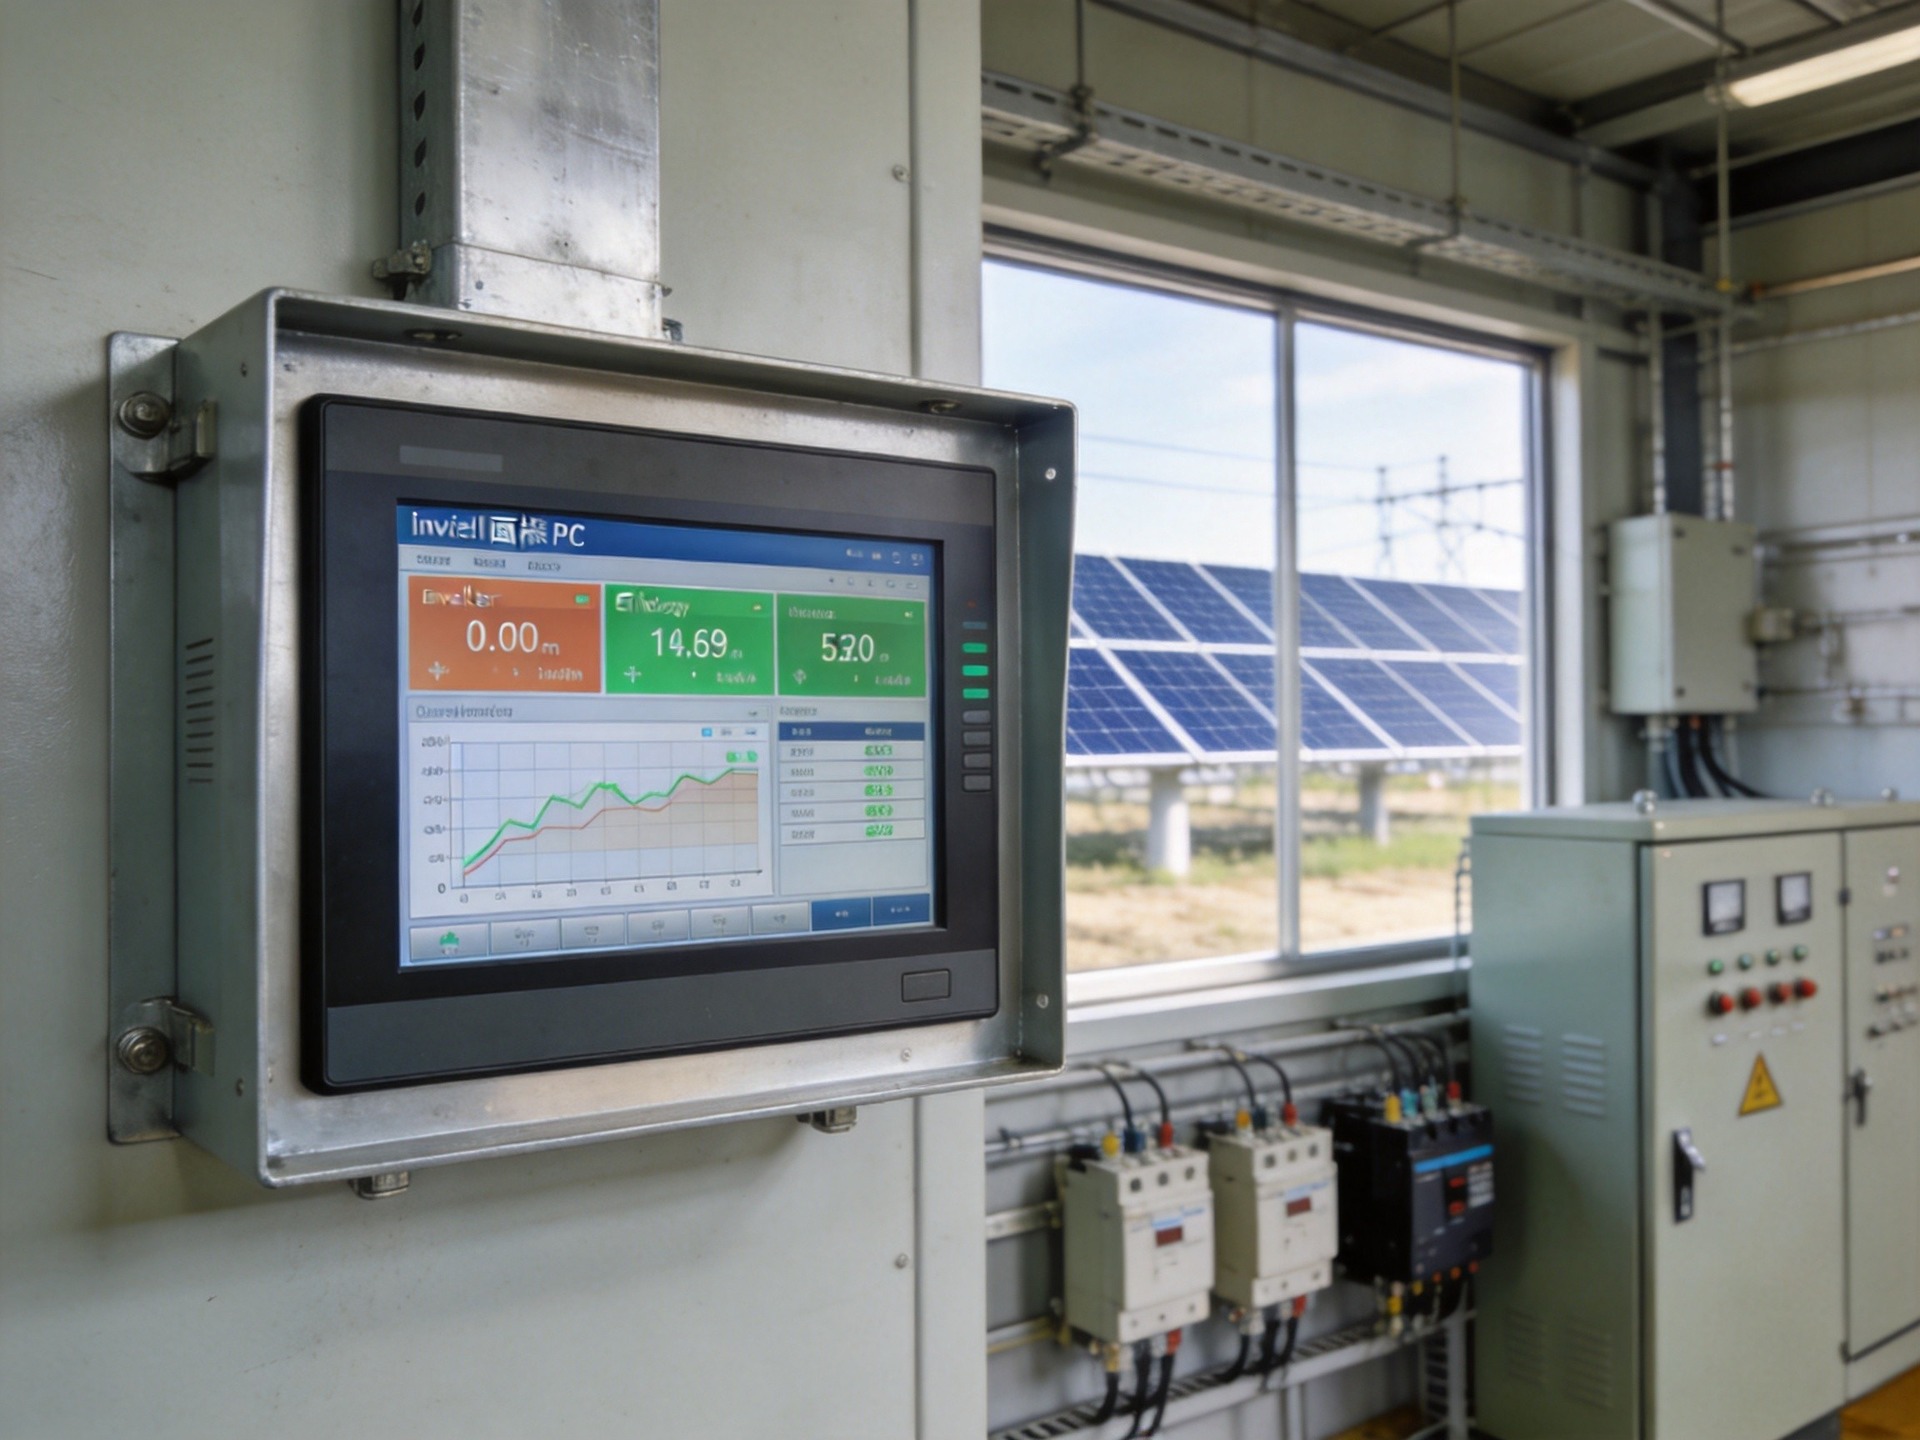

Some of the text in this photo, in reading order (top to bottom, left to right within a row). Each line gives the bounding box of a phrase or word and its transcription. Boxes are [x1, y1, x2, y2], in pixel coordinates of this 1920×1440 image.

[553, 522, 586, 547] PC
[466, 619, 539, 653] 0.00
[651, 627, 728, 658] 14.69
